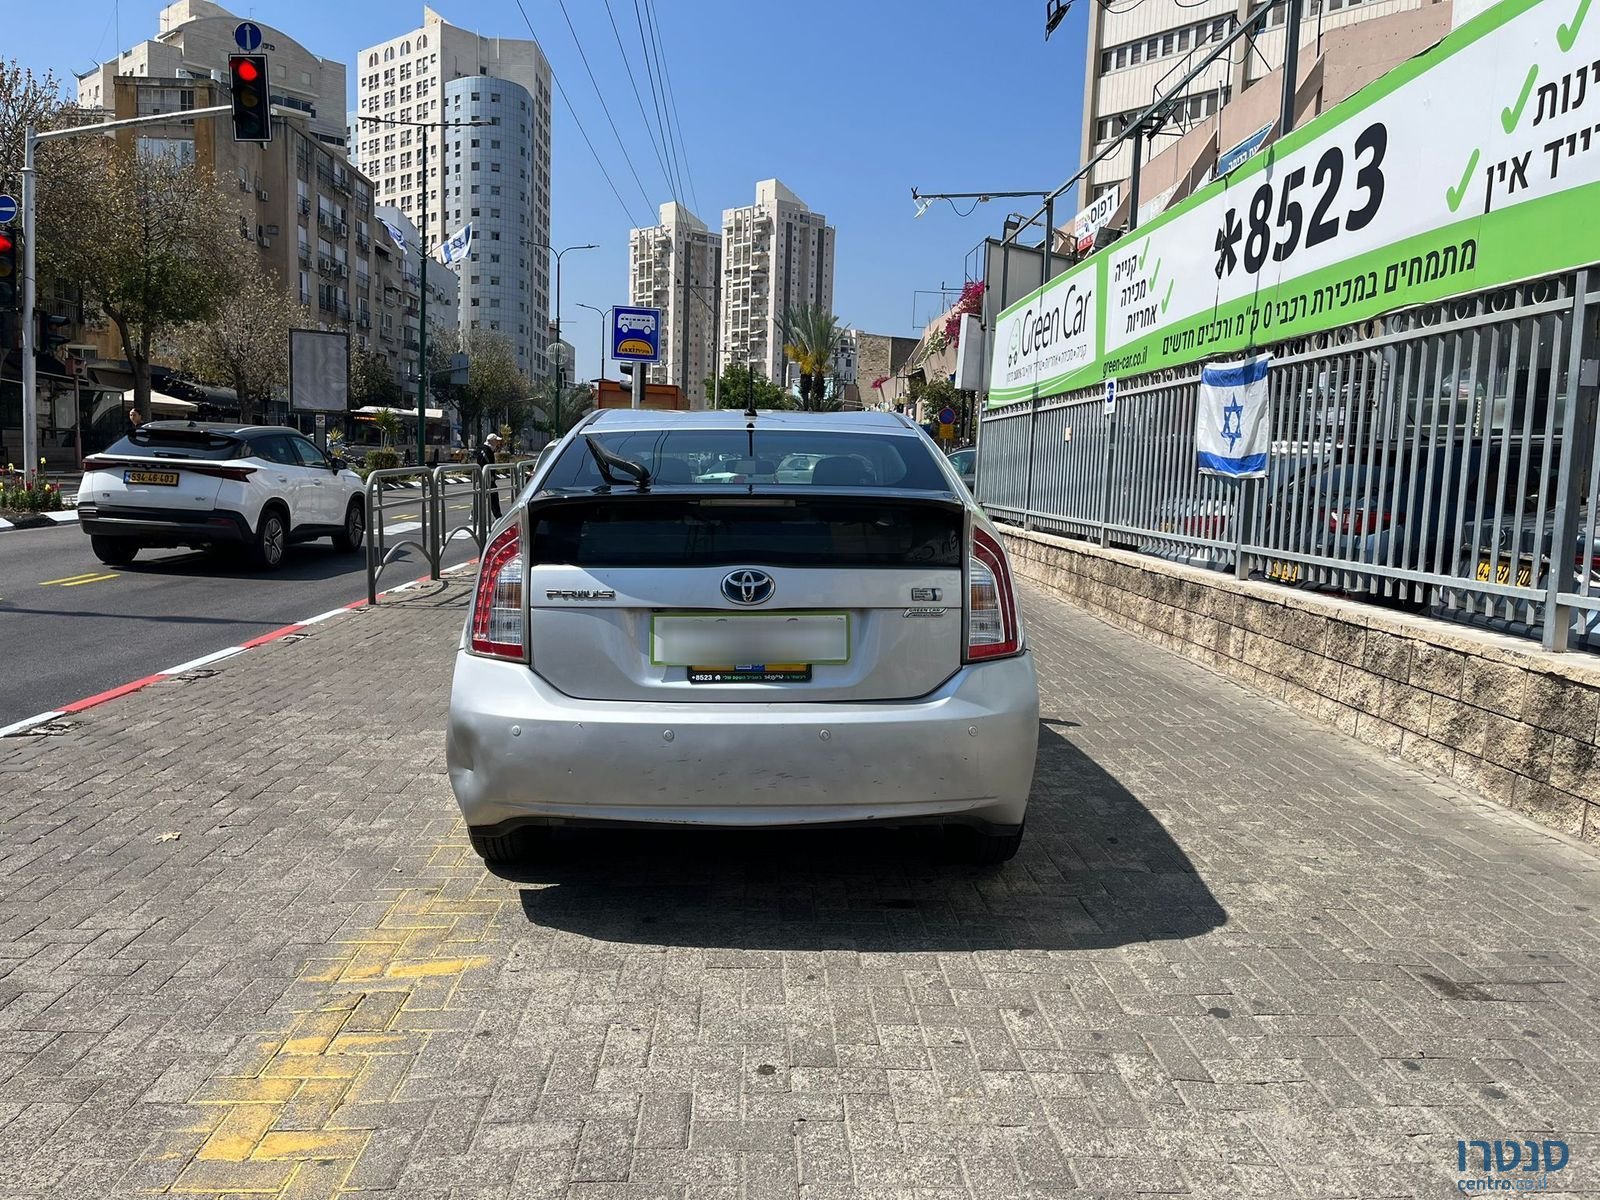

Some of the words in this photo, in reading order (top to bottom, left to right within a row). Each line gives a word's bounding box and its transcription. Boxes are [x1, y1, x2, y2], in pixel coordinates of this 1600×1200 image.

[1484, 150, 1533, 214] אין
[1114, 254, 1138, 283] קנייה
[1385, 239, 1477, 291] מתמחים
[1121, 279, 1147, 308] מכירה
[1311, 272, 1378, 315] במכירת
[1022, 307, 1060, 357] Green
[1063, 284, 1092, 339] Car
[1126, 304, 1158, 334] אחריות
[1263, 301, 1272, 328] 0
[1276, 294, 1307, 325] רכבי
[1162, 328, 1195, 356] חדשים
[1197, 316, 1233, 346] ורכבים
[1103, 346, 1148, 378] green-car.co.il
[546, 588, 616, 601] PRIUS
